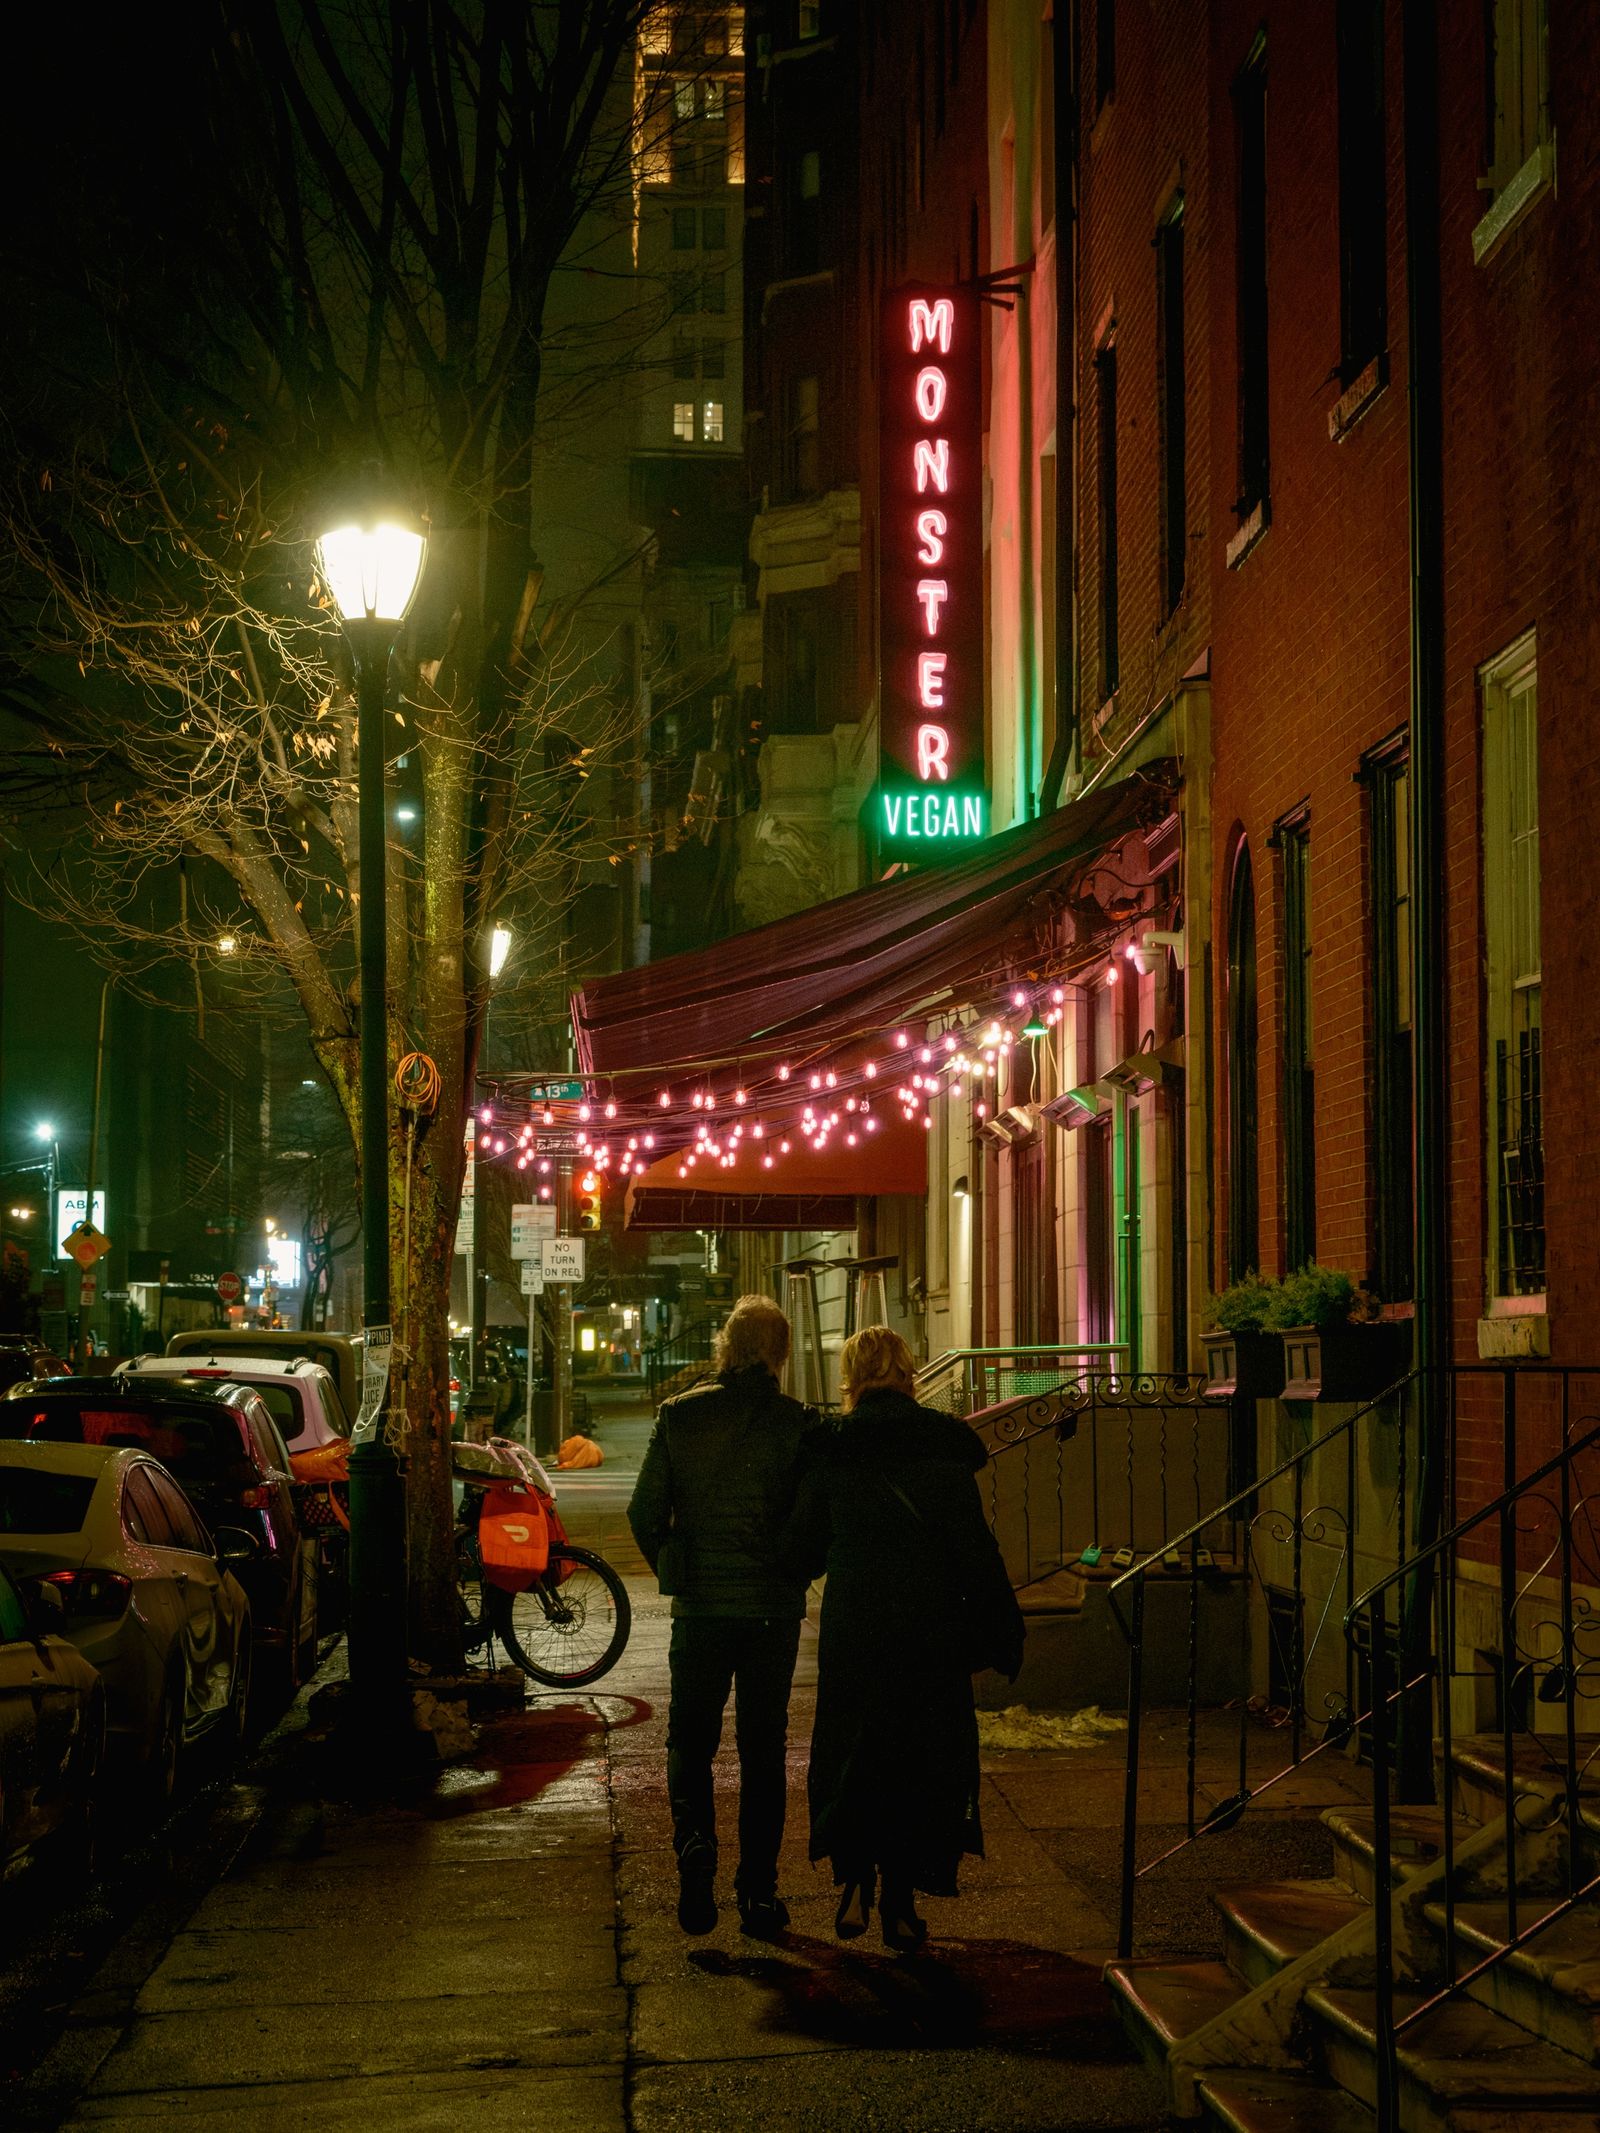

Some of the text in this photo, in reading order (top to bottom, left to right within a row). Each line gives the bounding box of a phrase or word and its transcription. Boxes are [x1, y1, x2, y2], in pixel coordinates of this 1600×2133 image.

[908, 299, 954, 781] MONSTER
[884, 794, 982, 837] VEGAN
[546, 1085, 569, 1098] 13th
[555, 1243, 570, 1252] NO
[550, 1255, 576, 1265] TURN
[545, 1268, 580, 1277] ON RED
[219, 1280, 240, 1293] STOP
